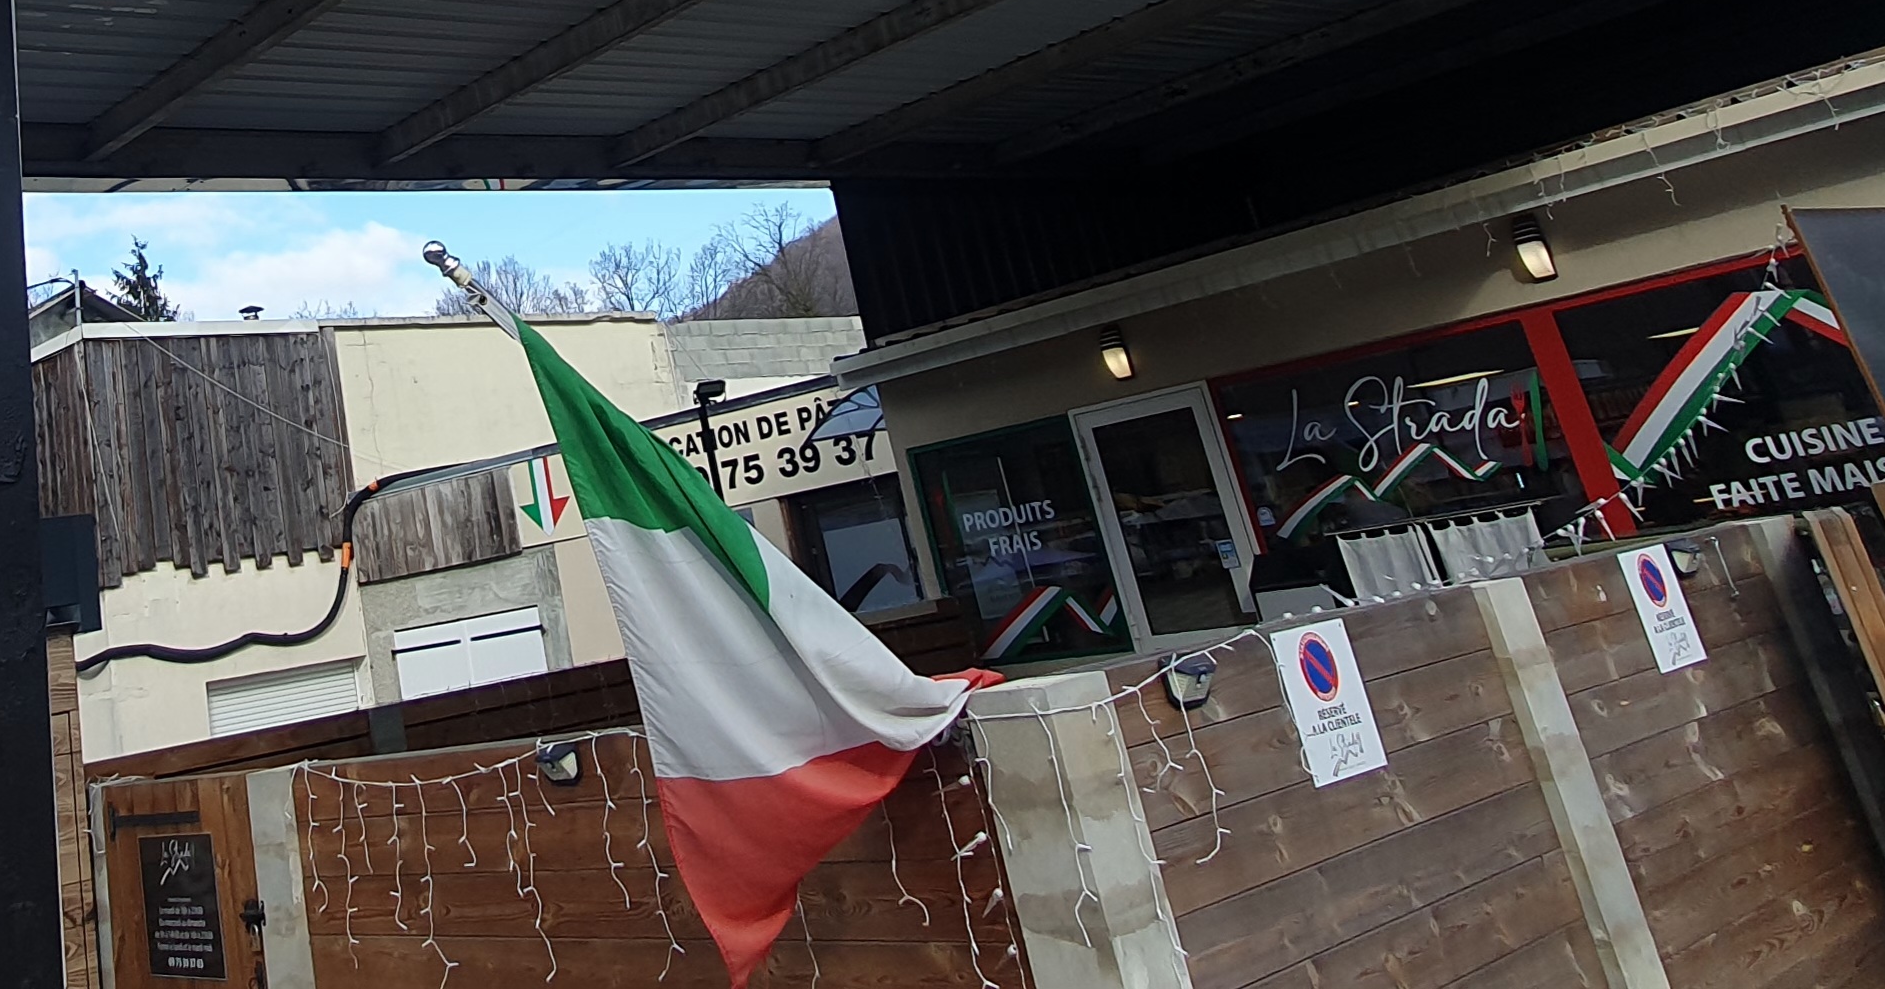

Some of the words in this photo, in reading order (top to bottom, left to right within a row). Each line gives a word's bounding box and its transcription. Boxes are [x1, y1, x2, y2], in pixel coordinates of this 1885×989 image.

[755, 411, 792, 441] DE
[1275, 388, 1337, 472] La
[1344, 375, 1526, 473] Strada
[1744, 417, 1885, 464] CUISINE
[720, 452, 765, 490] 75
[776, 443, 821, 478] 39
[832, 434, 876, 467] 37
[1708, 472, 1806, 510] FAITE
[962, 499, 1056, 533] PRODUITS
[988, 530, 1042, 558] FRAIS
